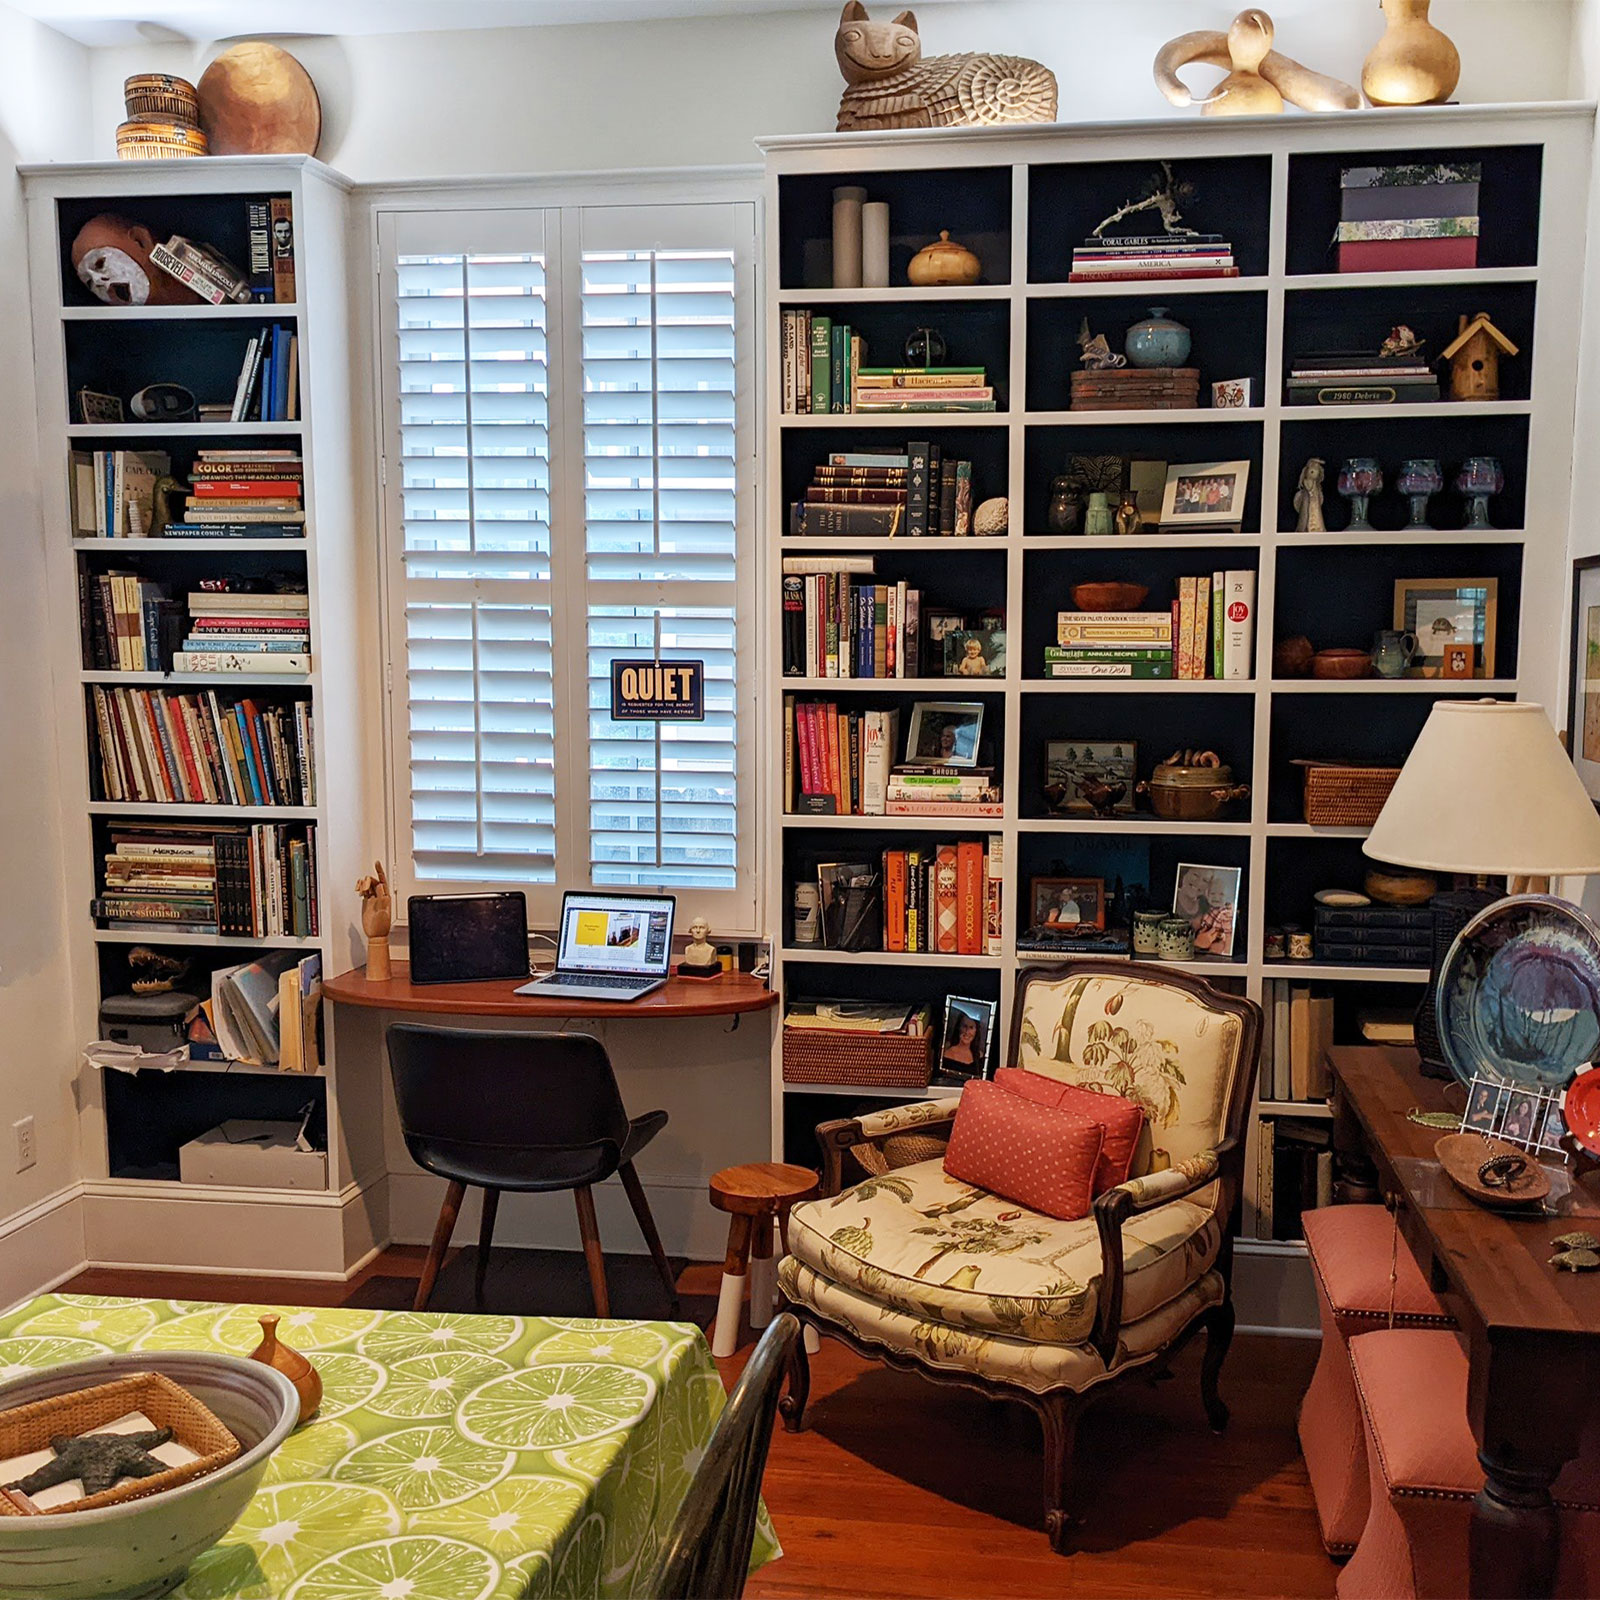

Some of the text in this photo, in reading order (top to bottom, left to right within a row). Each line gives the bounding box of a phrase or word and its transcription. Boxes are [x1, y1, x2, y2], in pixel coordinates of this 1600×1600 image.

[152, 247, 187, 276] ROOSEVELT
[250, 230, 269, 274] CHURCHILL
[198, 464, 232, 473] COLOR
[784, 591, 803, 600] ALASKA
[860, 596, 865, 605] On
[867, 596, 873, 605] On
[146, 610, 158, 641] Cape Cod
[1091, 666, 1126, 674] One Dish
[621, 668, 694, 700] QUIET
[299, 756, 308, 788] CARICATURE
[105, 906, 180, 918] Impressionism
[966, 894, 974, 940] COOKBOOK
